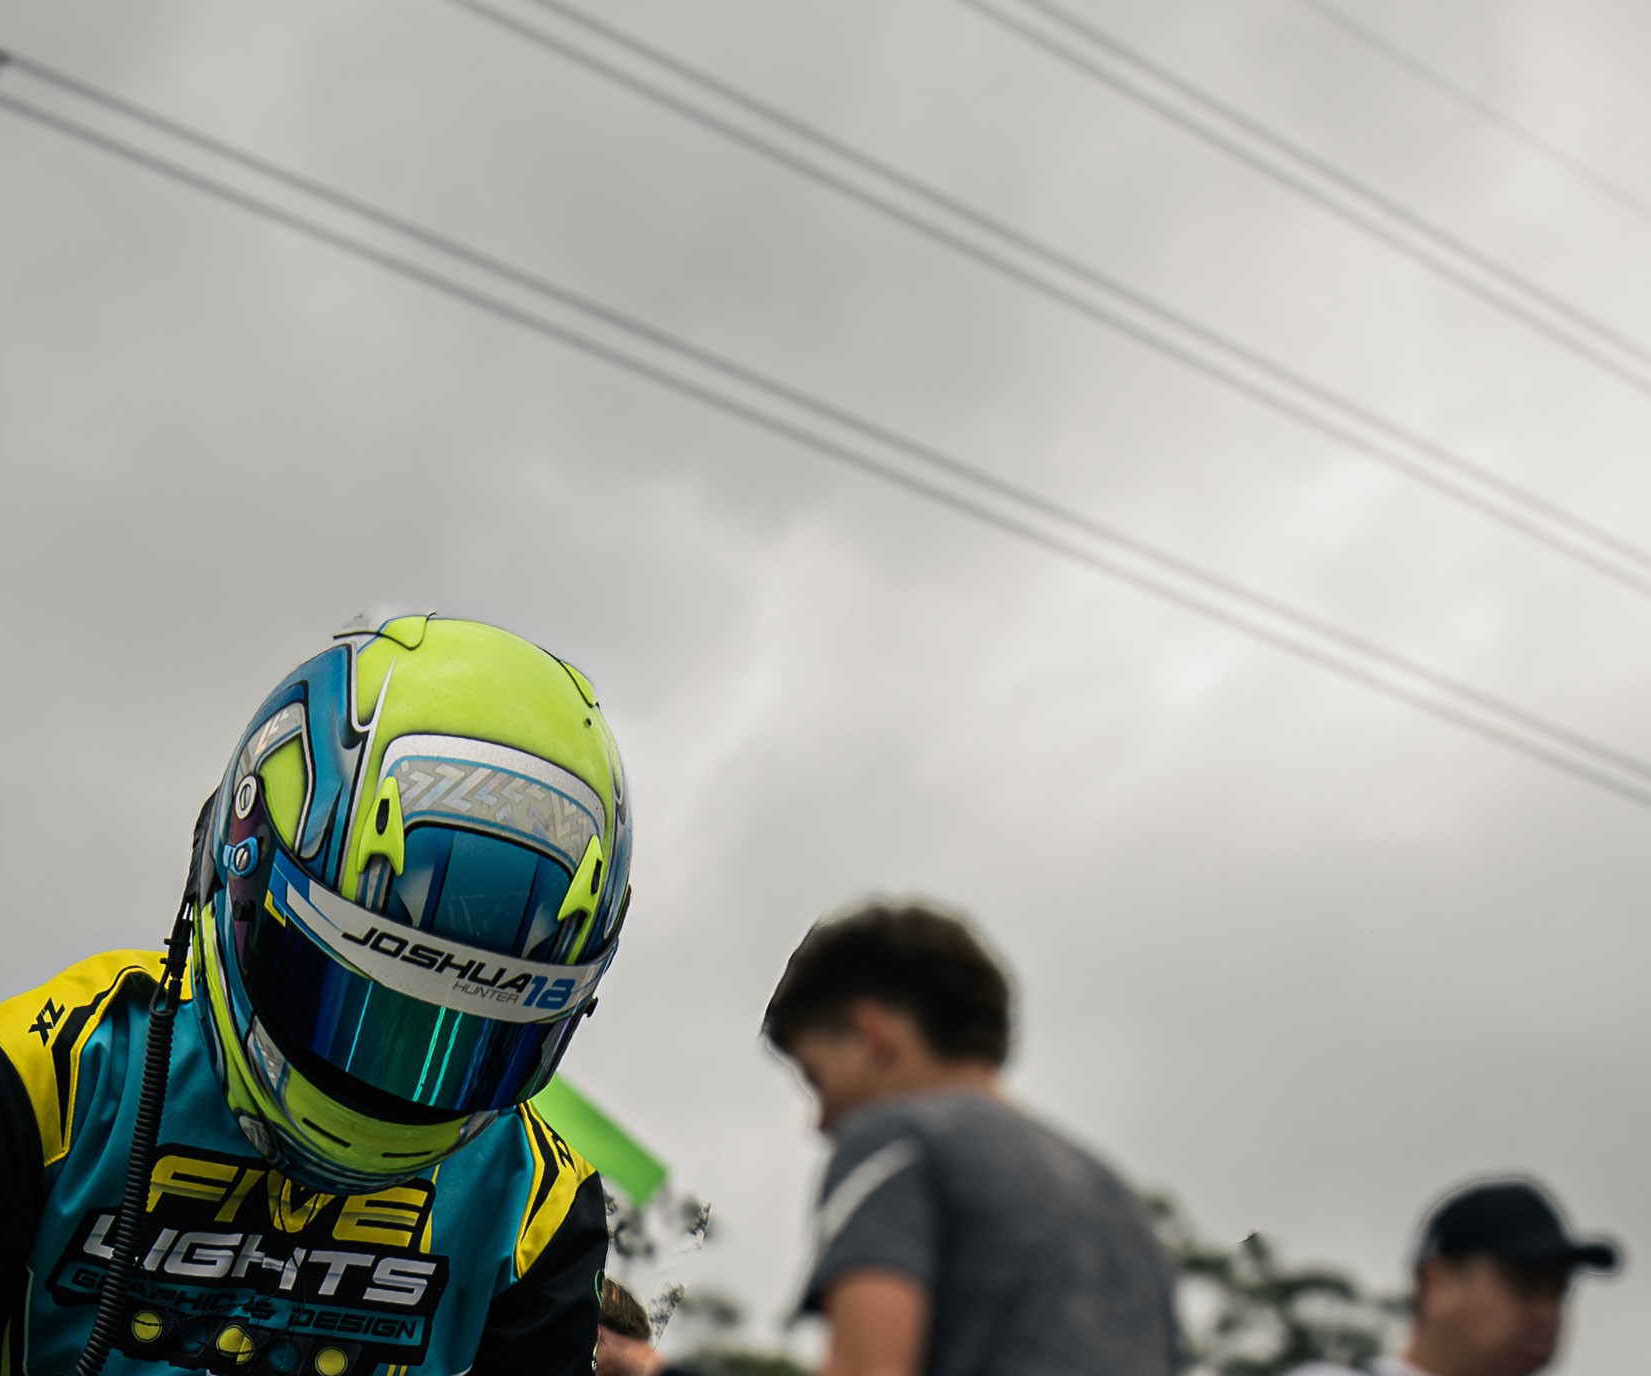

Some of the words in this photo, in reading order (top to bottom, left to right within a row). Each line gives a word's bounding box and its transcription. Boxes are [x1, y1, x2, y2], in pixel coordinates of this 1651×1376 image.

[341, 926, 533, 994] JOSHUA
[452, 980, 520, 1005] HUNTER
[146, 1154, 429, 1249] FIVE
[83, 1213, 437, 1306] LIGHTS
[288, 1307, 416, 1339] DESIGN
